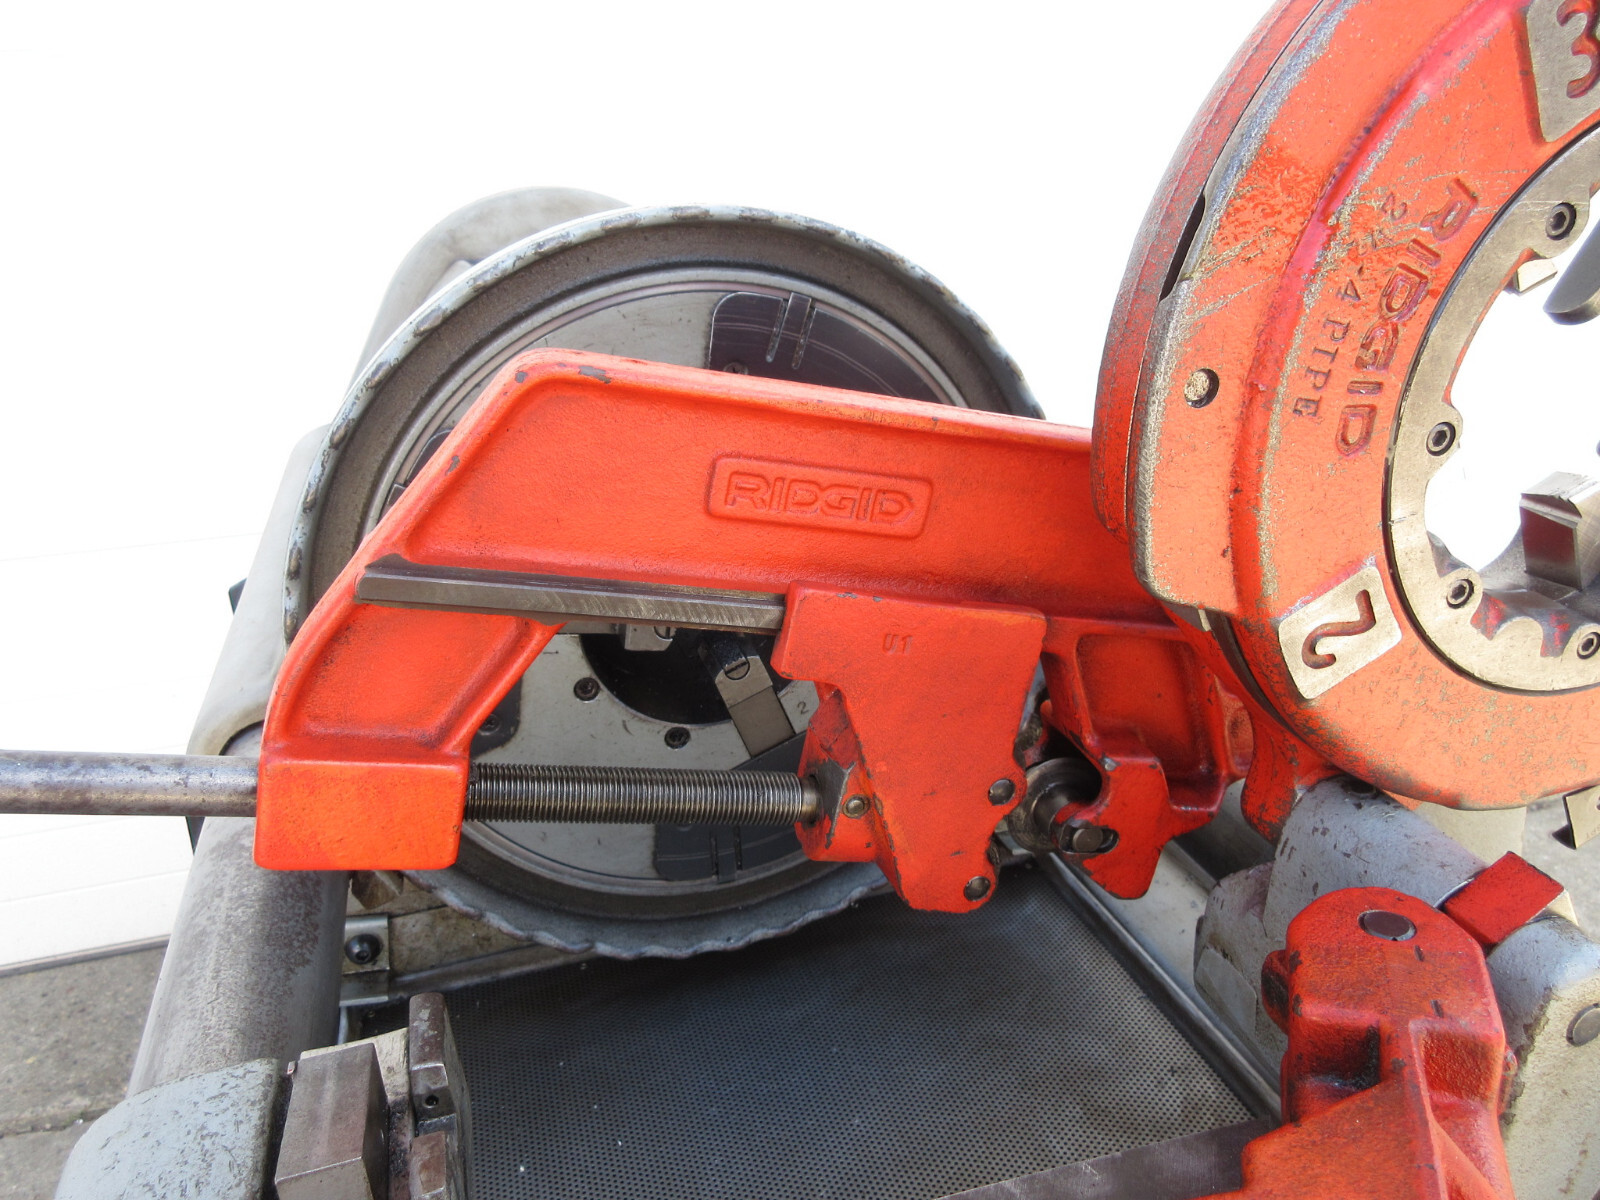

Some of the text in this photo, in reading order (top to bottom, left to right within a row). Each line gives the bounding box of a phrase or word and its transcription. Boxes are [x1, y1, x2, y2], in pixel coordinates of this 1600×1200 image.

[1336, 178, 1479, 456] RIDGID
[1293, 316, 1351, 418] PIPE
[724, 471, 914, 526] RIDGID
[1302, 589, 1377, 670] 2
[797, 701, 810, 716] 2
